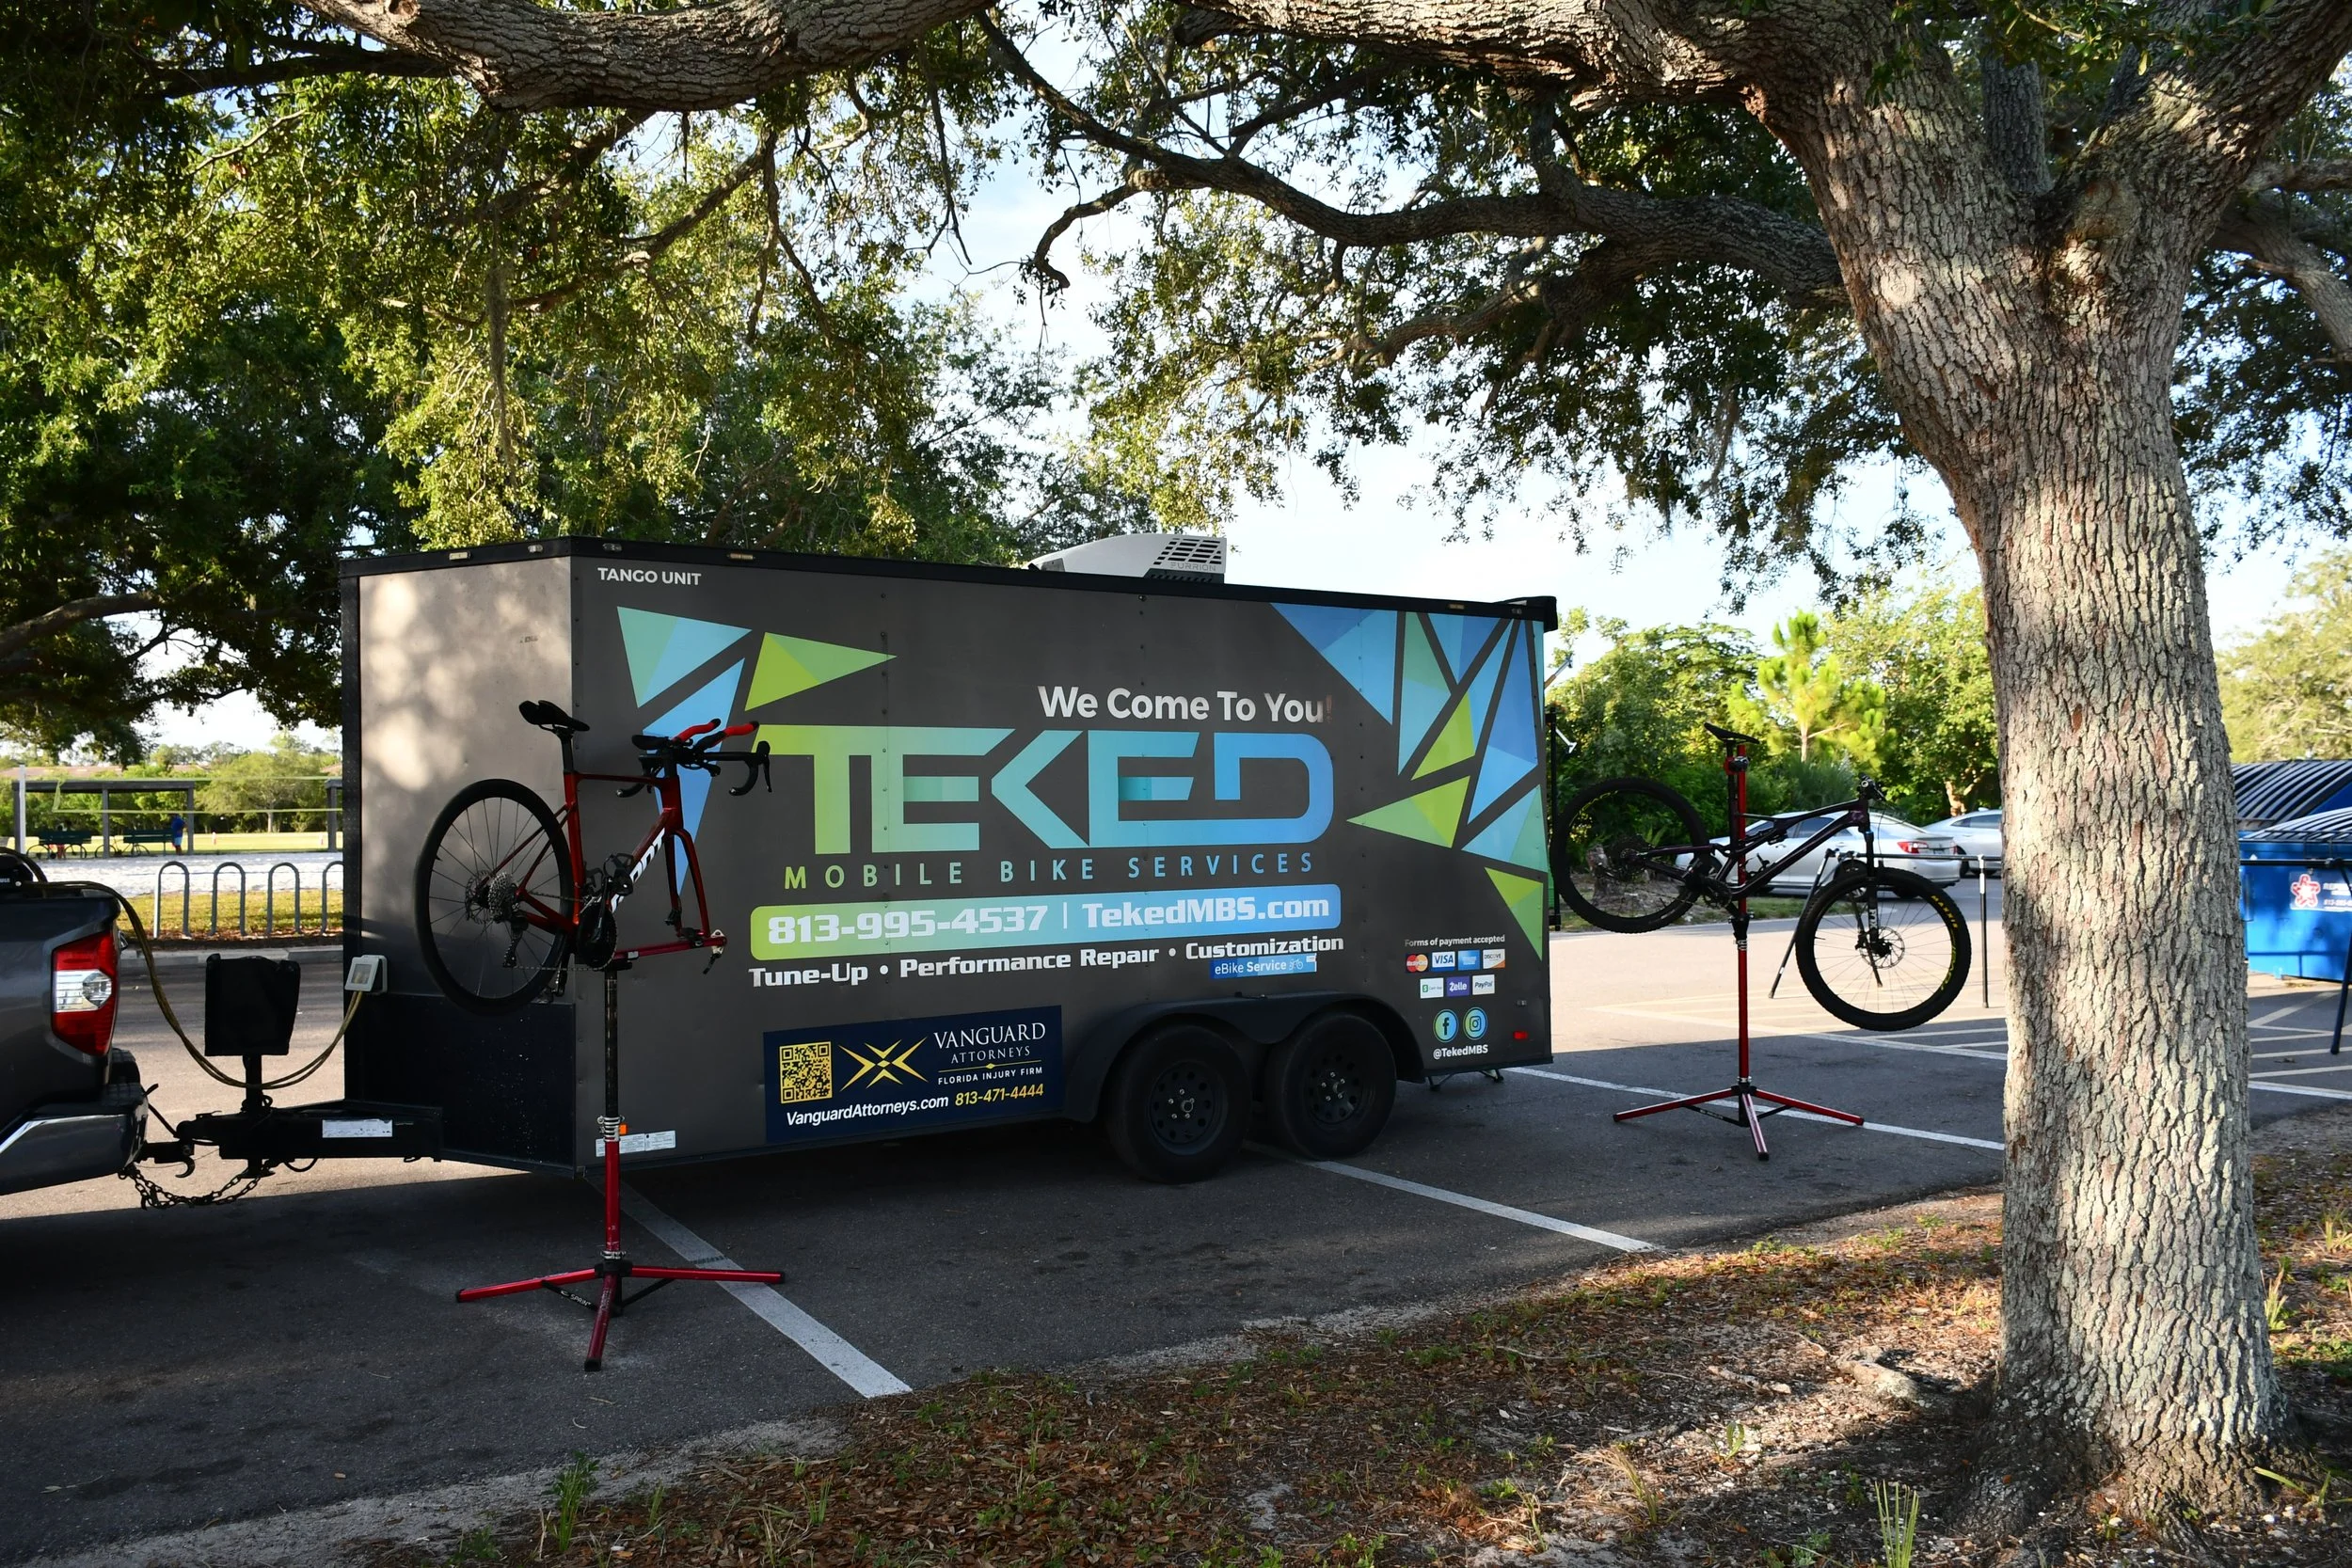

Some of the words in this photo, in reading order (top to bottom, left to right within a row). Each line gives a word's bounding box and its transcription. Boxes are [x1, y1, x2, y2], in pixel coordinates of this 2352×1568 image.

[597, 567, 659, 583] TANGO
[661, 571, 702, 586] UNIT
[1038, 686, 1098, 719] We
[1106, 687, 1210, 721] Come
[1216, 690, 1256, 721] To
[751, 724, 1334, 855] TEKED
[785, 862, 962, 890] MOBILE
[1000, 859, 1093, 882] BIKE
[1128, 852, 1311, 879] SERVICES
[768, 905, 1048, 944] 813-995-4537
[1082, 896, 1329, 928] TekedMBS.com
[1405, 939, 1428, 947] Forms
[1430, 938, 1438, 946] of
[1438, 936, 1472, 947] payment
[1472, 934, 1505, 945] accepted
[748, 962, 868, 988] Tune-Up
[899, 954, 1072, 978] Performance
[1080, 947, 1160, 969] Repair
[1185, 935, 1344, 960] Customization
[1215, 962, 1244, 974] eBike
[1247, 959, 1287, 973] Service
[1435, 954, 1454, 964] VISA
[1449, 981, 1468, 991] Zelle
[1474, 981, 1493, 990] PayPal
[933, 1022, 1046, 1050] VANGUARD
[950, 1045, 1031, 1064] ATTORNEYS
[1433, 1044, 1488, 1060] @TekedMBS
[938, 1073, 978, 1085] FLORIDA
[982, 1069, 1017, 1081] INJURY
[1021, 1066, 1042, 1077] FIRM
[786, 1095, 949, 1127] VanguardAttorneys.com
[954, 1083, 1044, 1106] 813-471-4444
